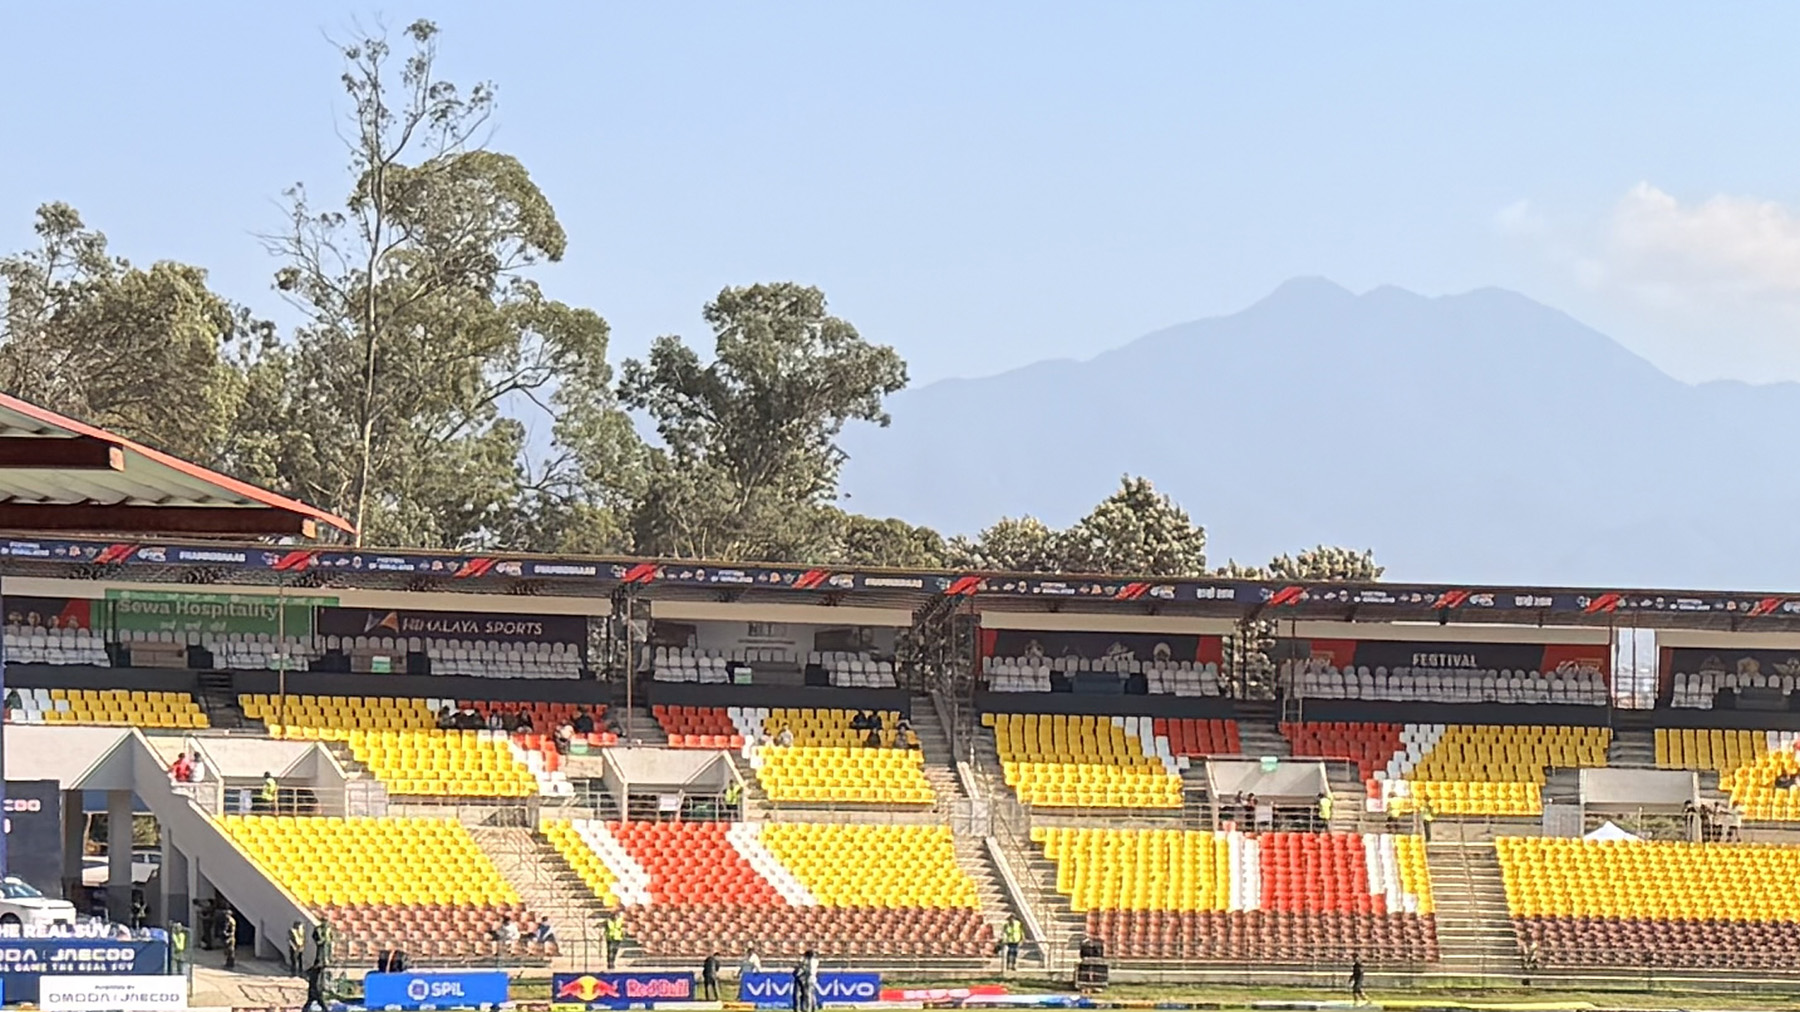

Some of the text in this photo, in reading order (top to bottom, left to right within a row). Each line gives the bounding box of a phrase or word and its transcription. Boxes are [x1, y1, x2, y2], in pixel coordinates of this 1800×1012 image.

[176, 600, 279, 622] Hospitality
[484, 620, 543, 636] SPORTS
[1411, 652, 1479, 668] FESTIVAL
[23, 922, 72, 939] REAL
[74, 922, 111, 939] SUV
[746, 977, 794, 997] viv
[815, 977, 875, 997] vivo
